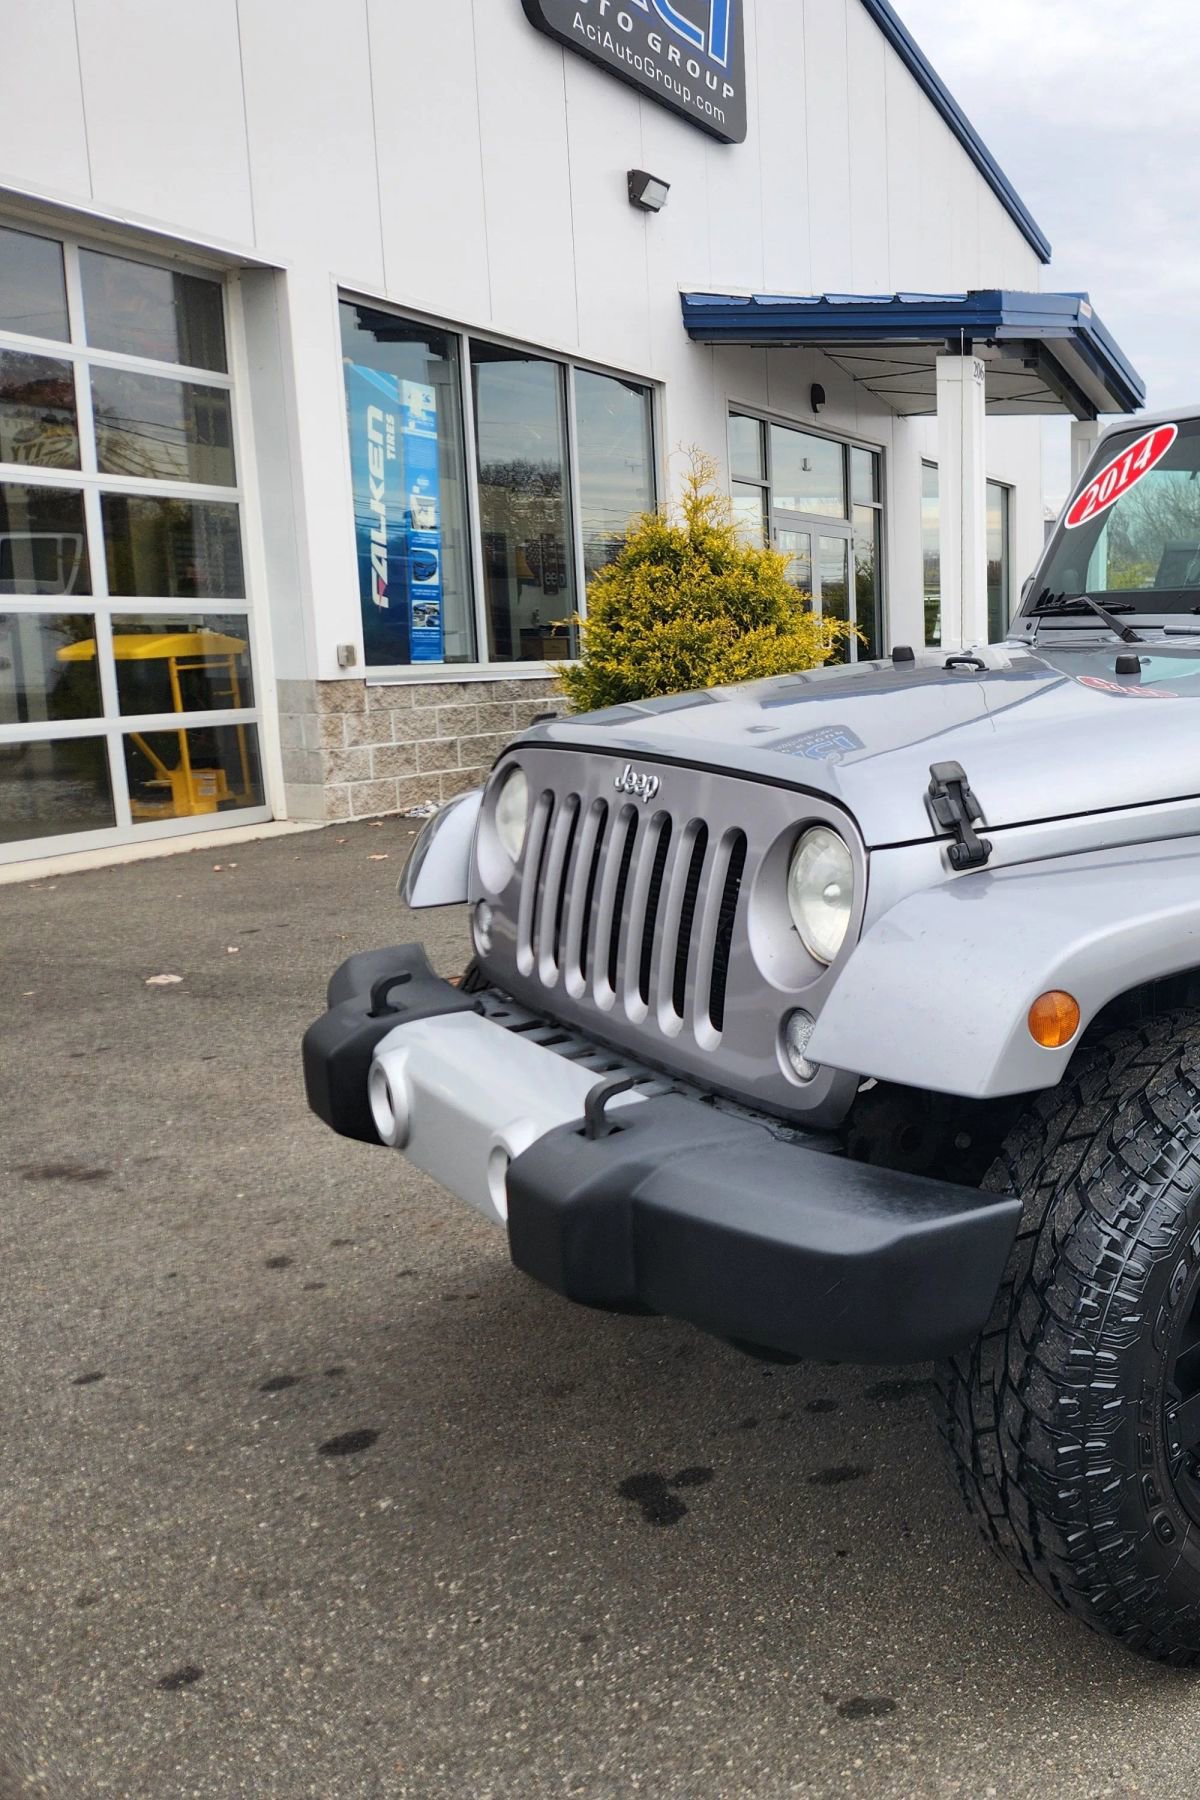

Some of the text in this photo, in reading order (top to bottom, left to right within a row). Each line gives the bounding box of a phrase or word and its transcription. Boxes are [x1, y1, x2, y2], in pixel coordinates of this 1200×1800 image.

[572, 12, 726, 124] AciAutoGroup.com
[579, 0, 735, 99] TO GROUP
[386, 414, 396, 460] TIRES
[1079, 433, 1156, 521] 2014
[614, 764, 659, 803] Jeep
